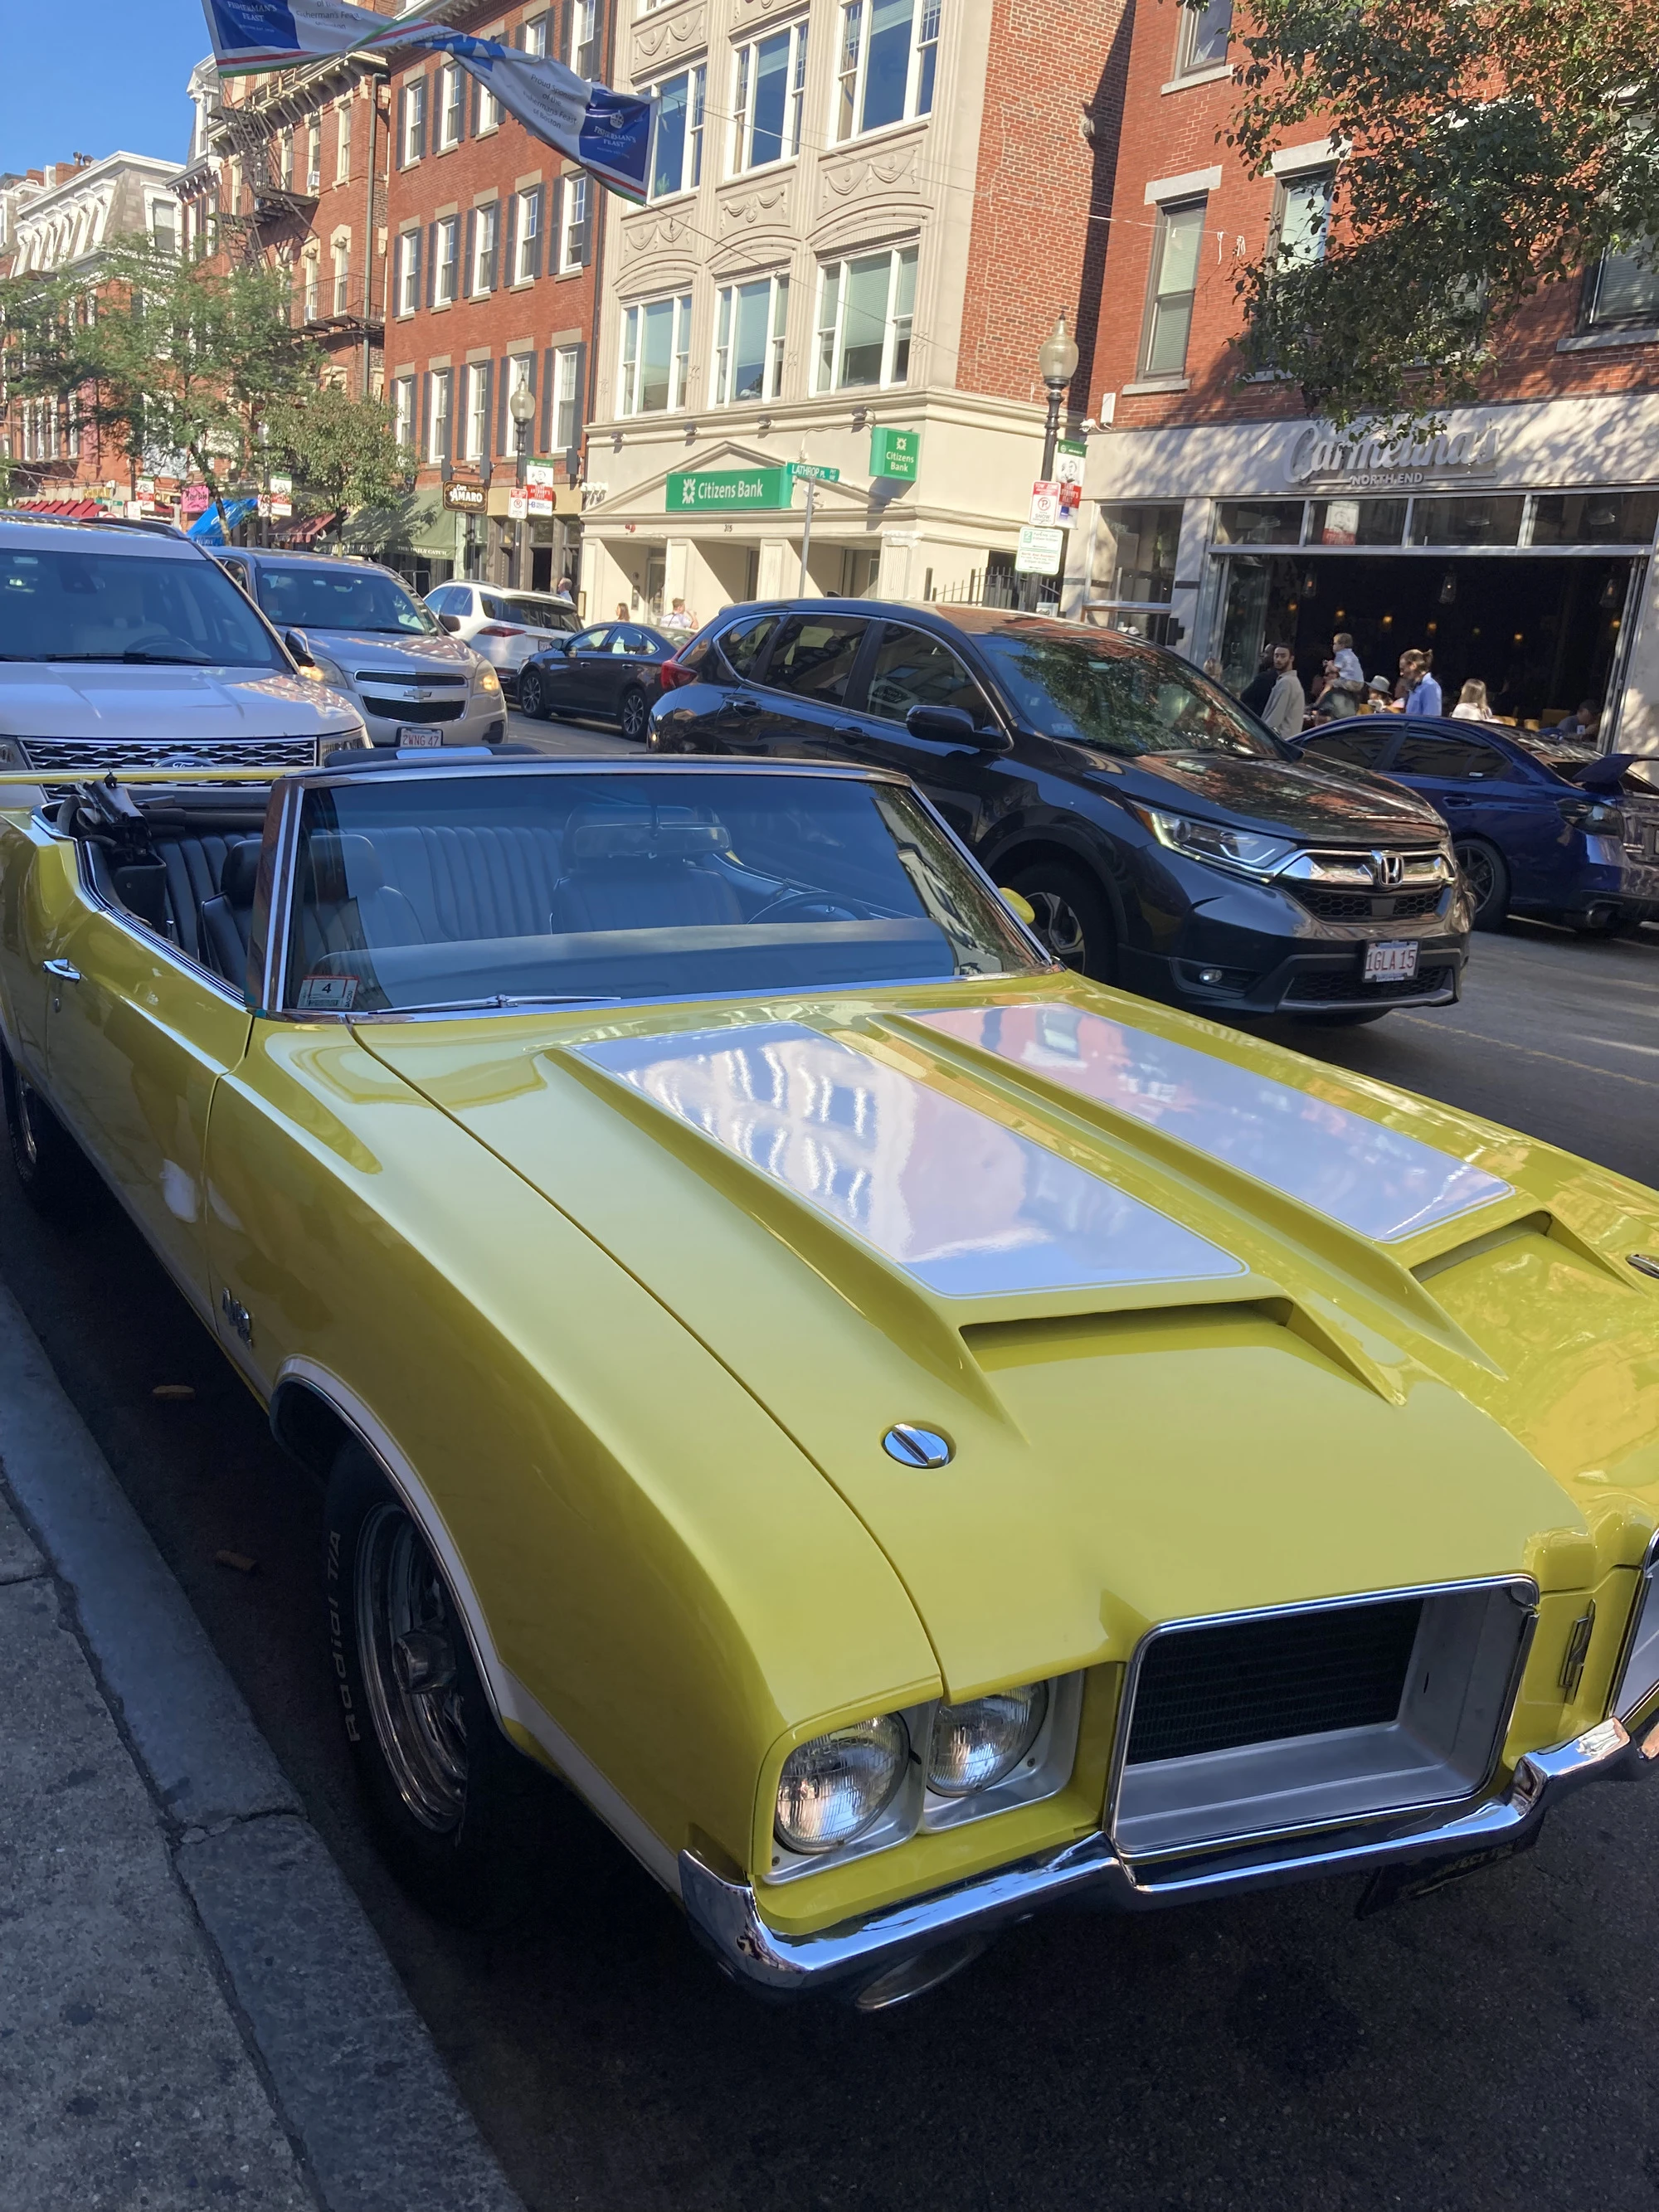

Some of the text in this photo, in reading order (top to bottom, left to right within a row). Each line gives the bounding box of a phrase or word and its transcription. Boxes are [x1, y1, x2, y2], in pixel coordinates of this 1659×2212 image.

[241, 12, 265, 22] FEAST
[531, 73, 552, 89] Proud
[558, 110, 578, 124] Feast
[594, 125, 636, 143] FISHERMAN'S
[603, 139, 625, 148] FEAST
[886, 451, 914, 464] Citizens
[791, 464, 820, 477] LATHROP
[890, 461, 908, 472] Bank
[1351, 472, 1424, 485] NORTH END
[450, 488, 483, 503] AMARO
[698, 479, 763, 499] Citizens Bank
[402, 735, 440, 746] 2WNG 47
[1365, 950, 1416, 971] 1GLA 15
[321, 982, 332, 994] 4
[328, 1596, 361, 1742] Radial
